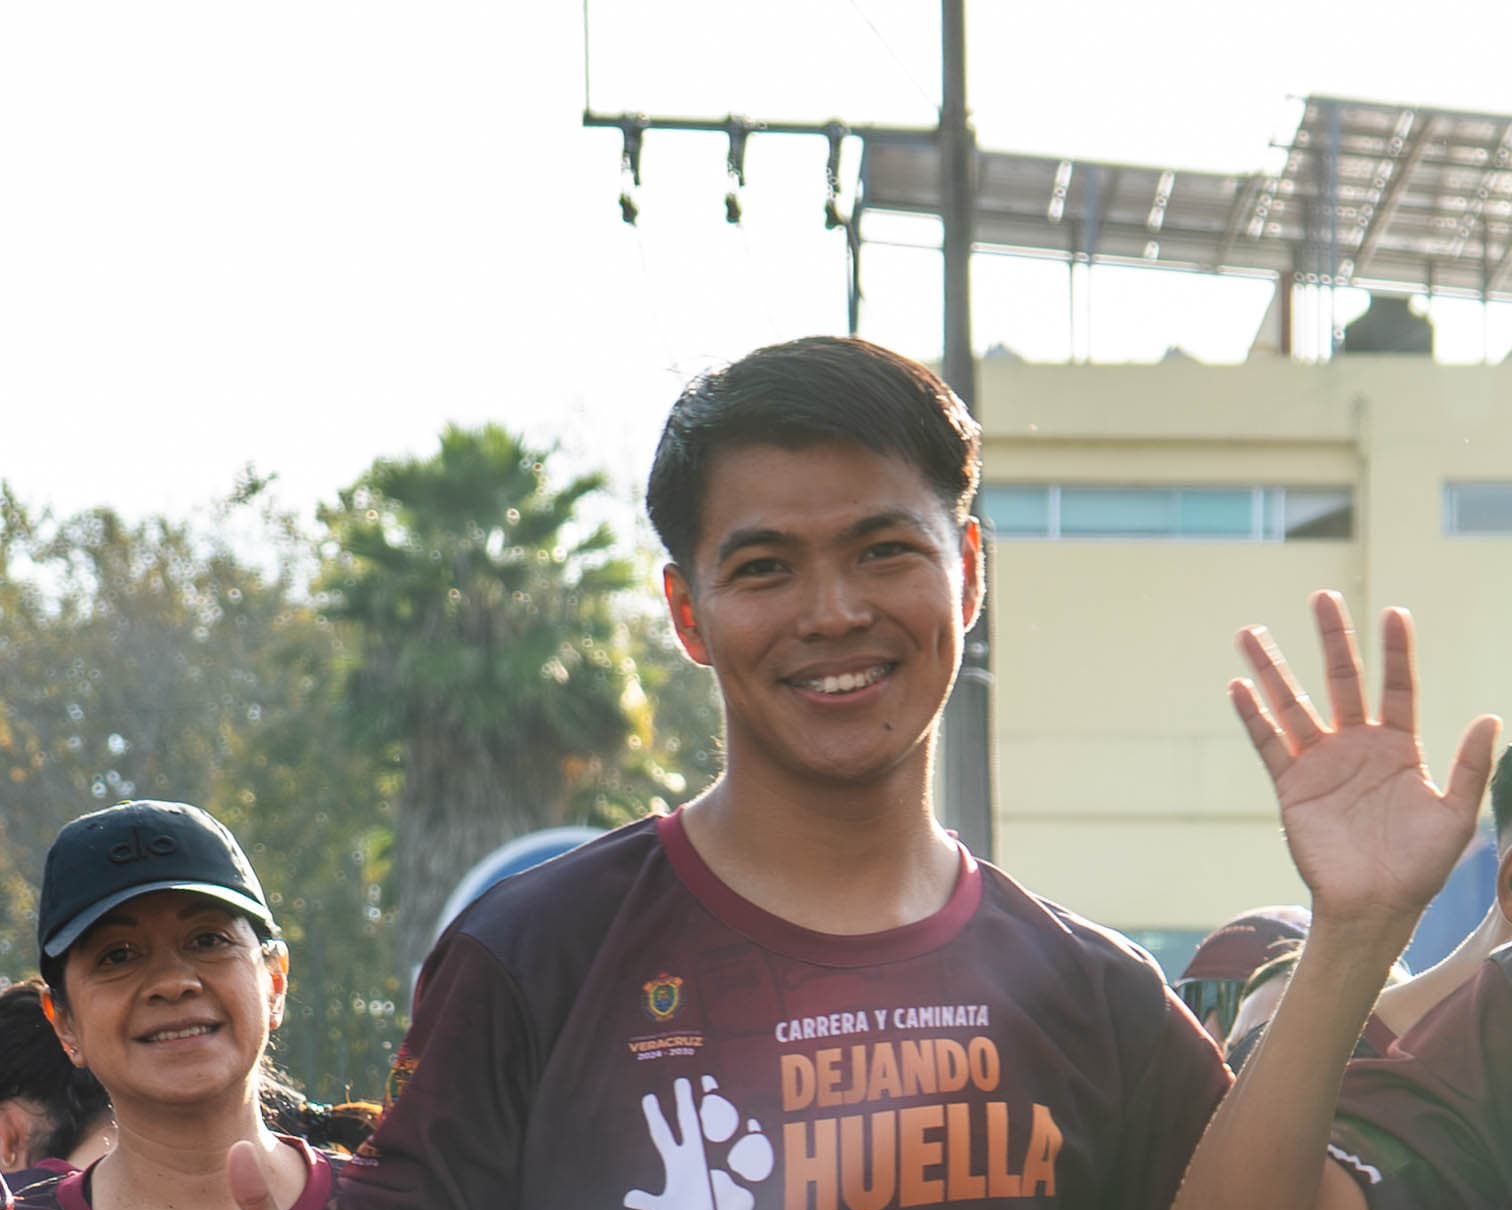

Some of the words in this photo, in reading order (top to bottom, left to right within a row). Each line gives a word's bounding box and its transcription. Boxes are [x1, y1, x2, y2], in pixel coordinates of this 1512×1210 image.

[775, 1009, 869, 1043] CARRERA
[875, 1008, 889, 1030] Y
[893, 1004, 990, 1029] CAMINATA
[627, 1036, 705, 1053] VERACRUZ
[780, 1036, 1001, 1112] DEJANDO
